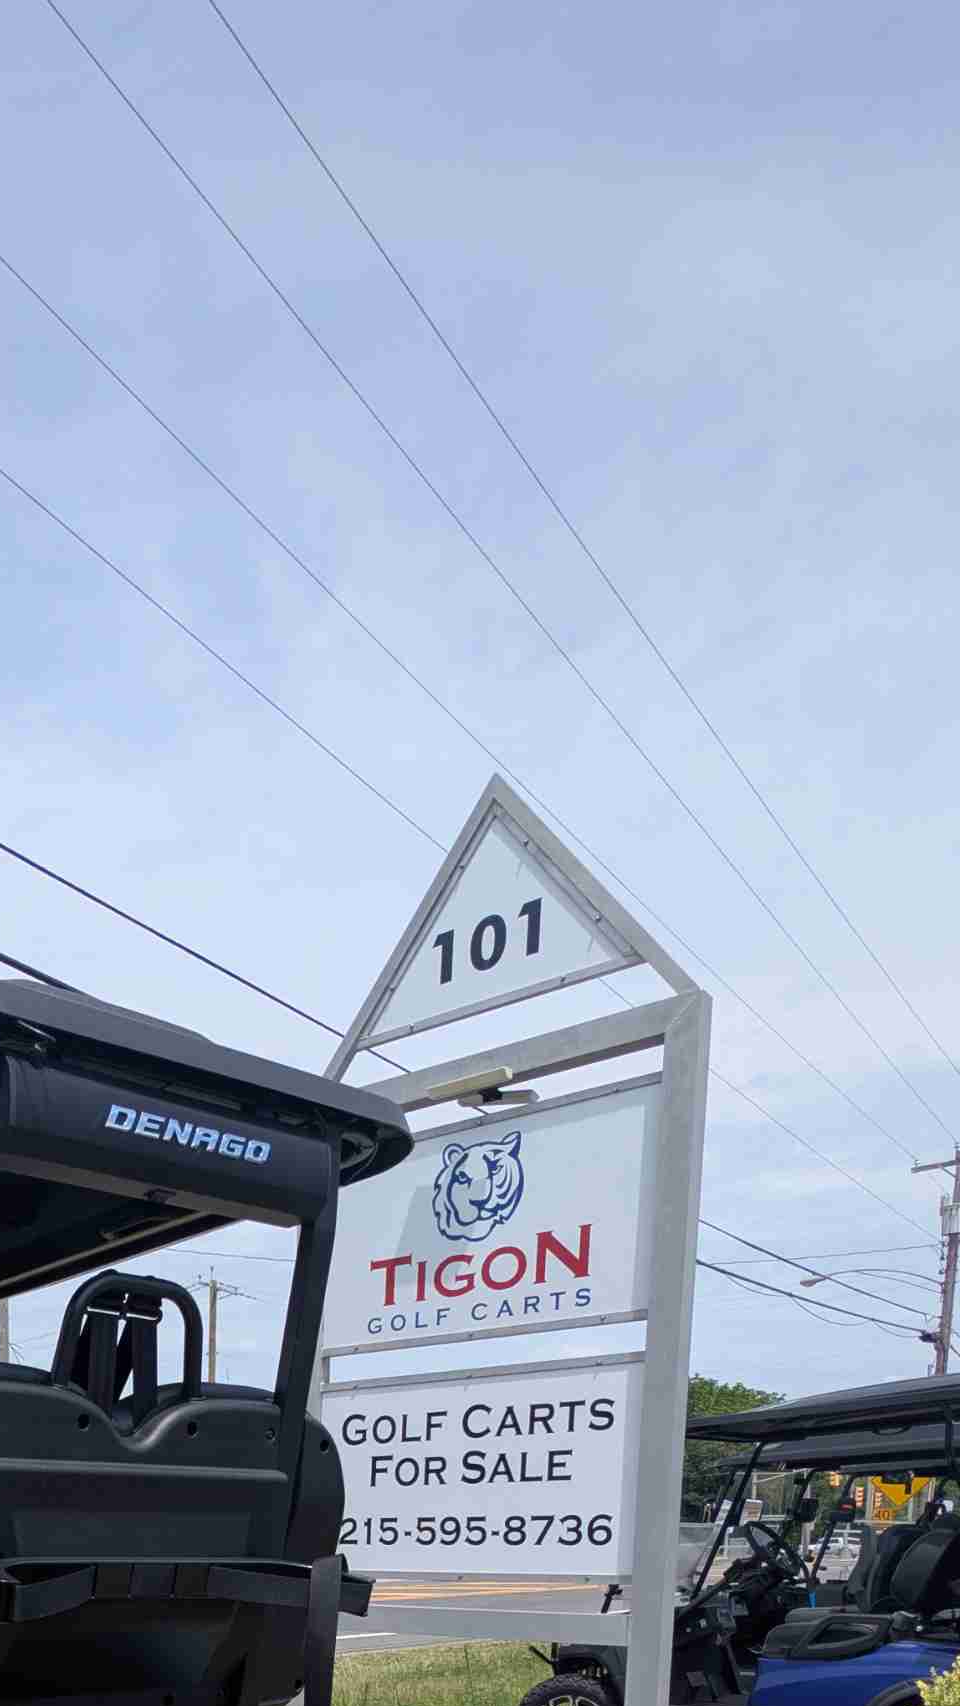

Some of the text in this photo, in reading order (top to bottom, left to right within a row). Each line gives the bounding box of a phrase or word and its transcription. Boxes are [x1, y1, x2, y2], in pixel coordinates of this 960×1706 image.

[432, 897, 542, 985] 101
[105, 1104, 272, 1164] DENAGO
[370, 1224, 592, 1306] TIGON
[367, 1288, 591, 1334] GOLF CARTS
[342, 1398, 616, 1446] GOLF CARTS
[370, 1449, 574, 1488] FOR SALE
[339, 1513, 613, 1546] 215-595-8736
